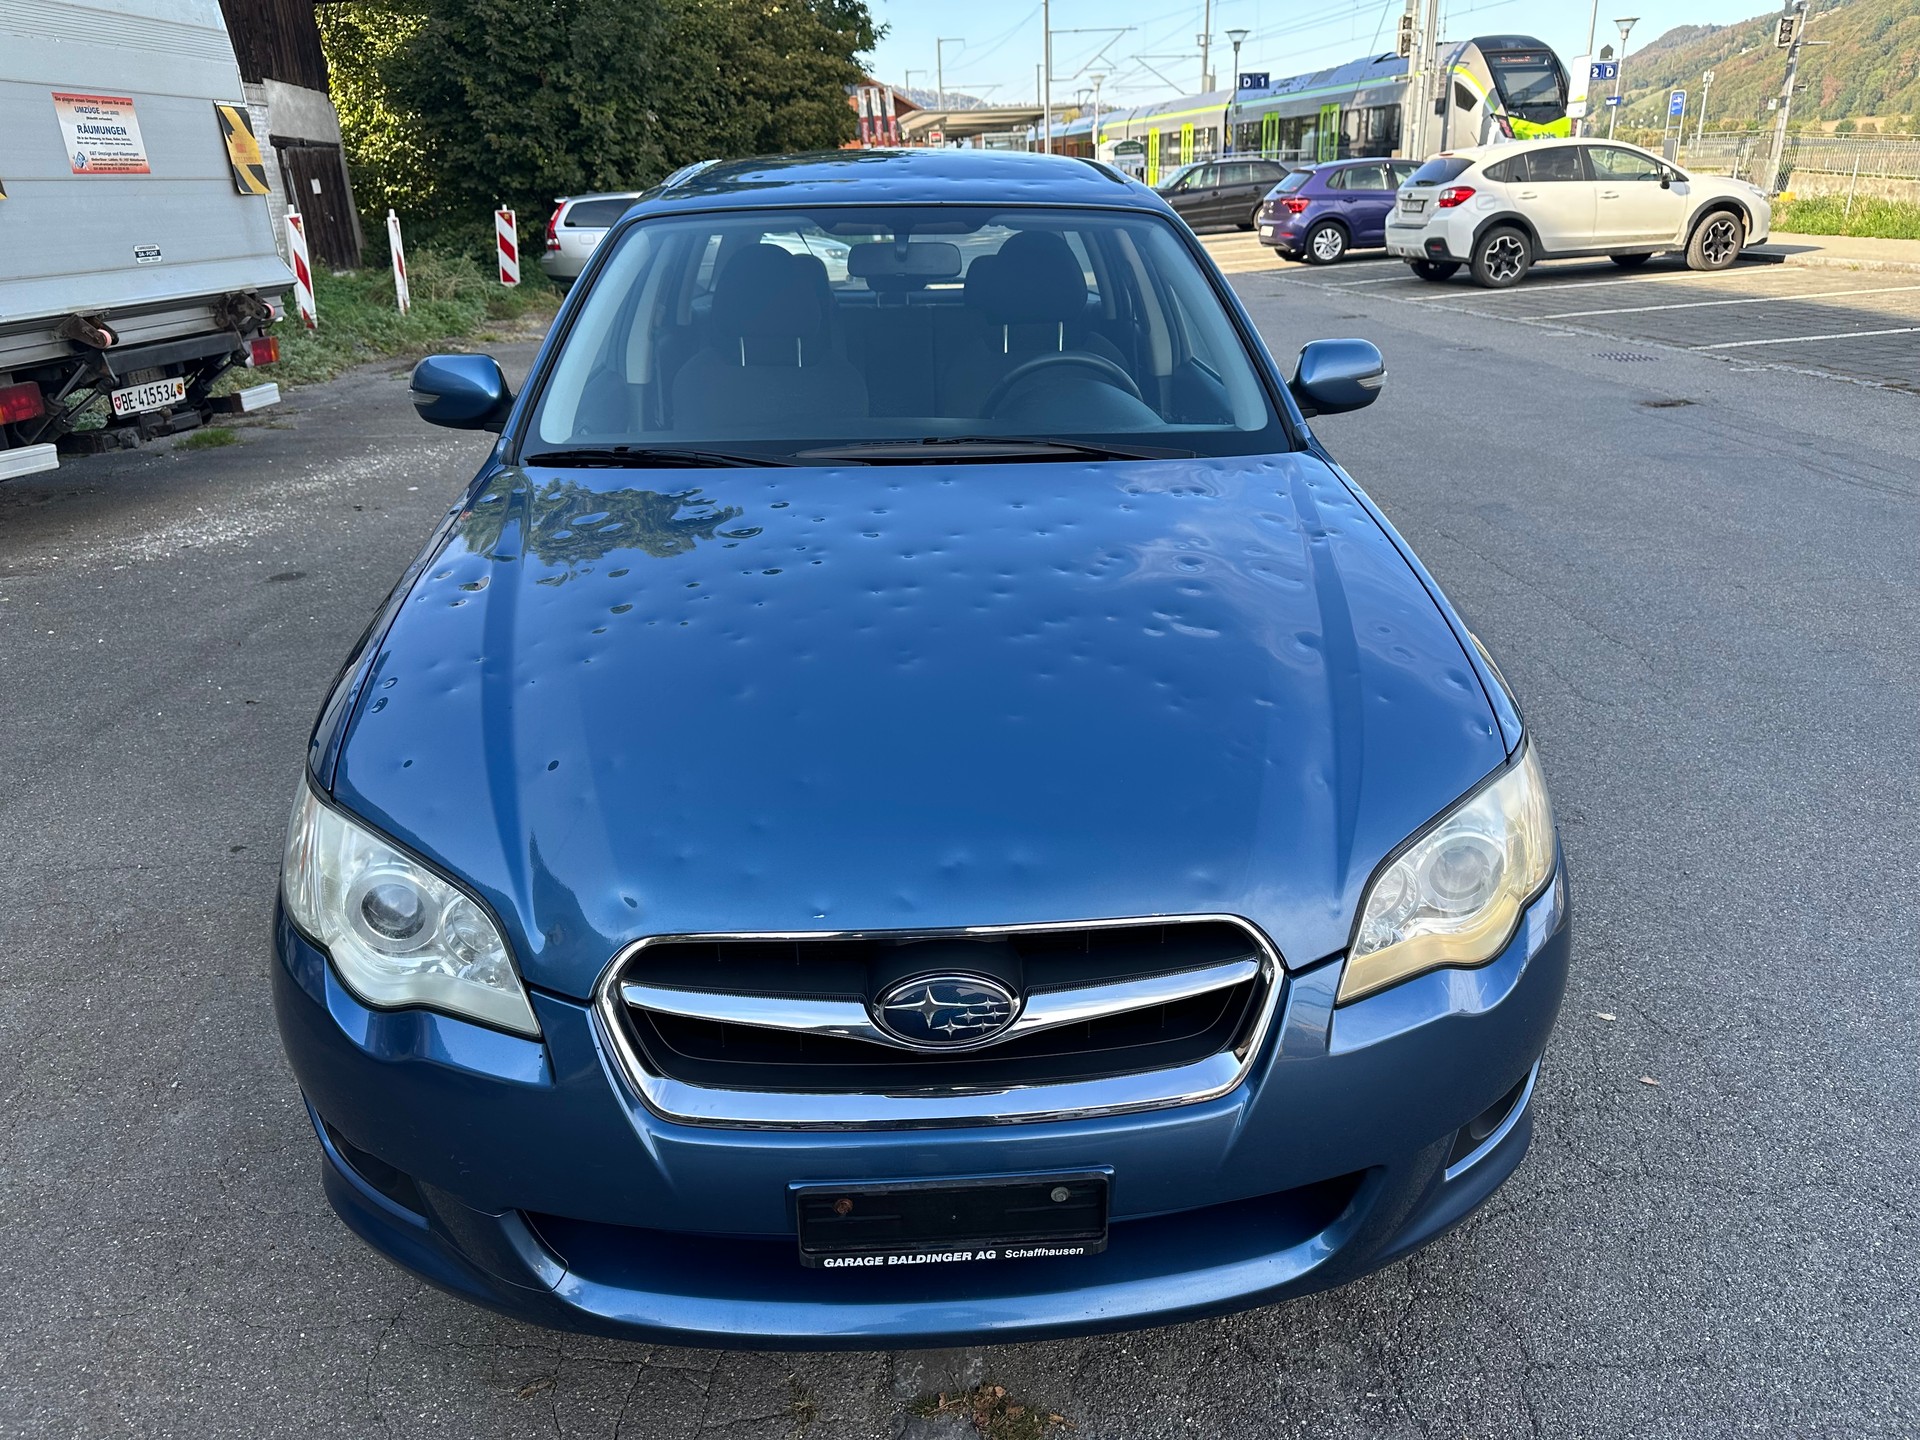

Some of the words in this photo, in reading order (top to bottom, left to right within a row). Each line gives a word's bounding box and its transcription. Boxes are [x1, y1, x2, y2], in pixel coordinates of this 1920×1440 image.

[1591, 68, 1599, 77] 2
[1606, 67, 1614, 77] D
[1243, 77, 1251, 88] D
[1260, 76, 1265, 88] 1
[74, 105, 100, 115] UMZÜGE
[76, 122, 127, 135] RÄUMUNGEN
[824, 1256, 884, 1268] GARAGE
[888, 1252, 972, 1265] BALDINGER
[975, 1250, 997, 1260] AG
[1004, 1247, 1084, 1259] Schaffhausen
